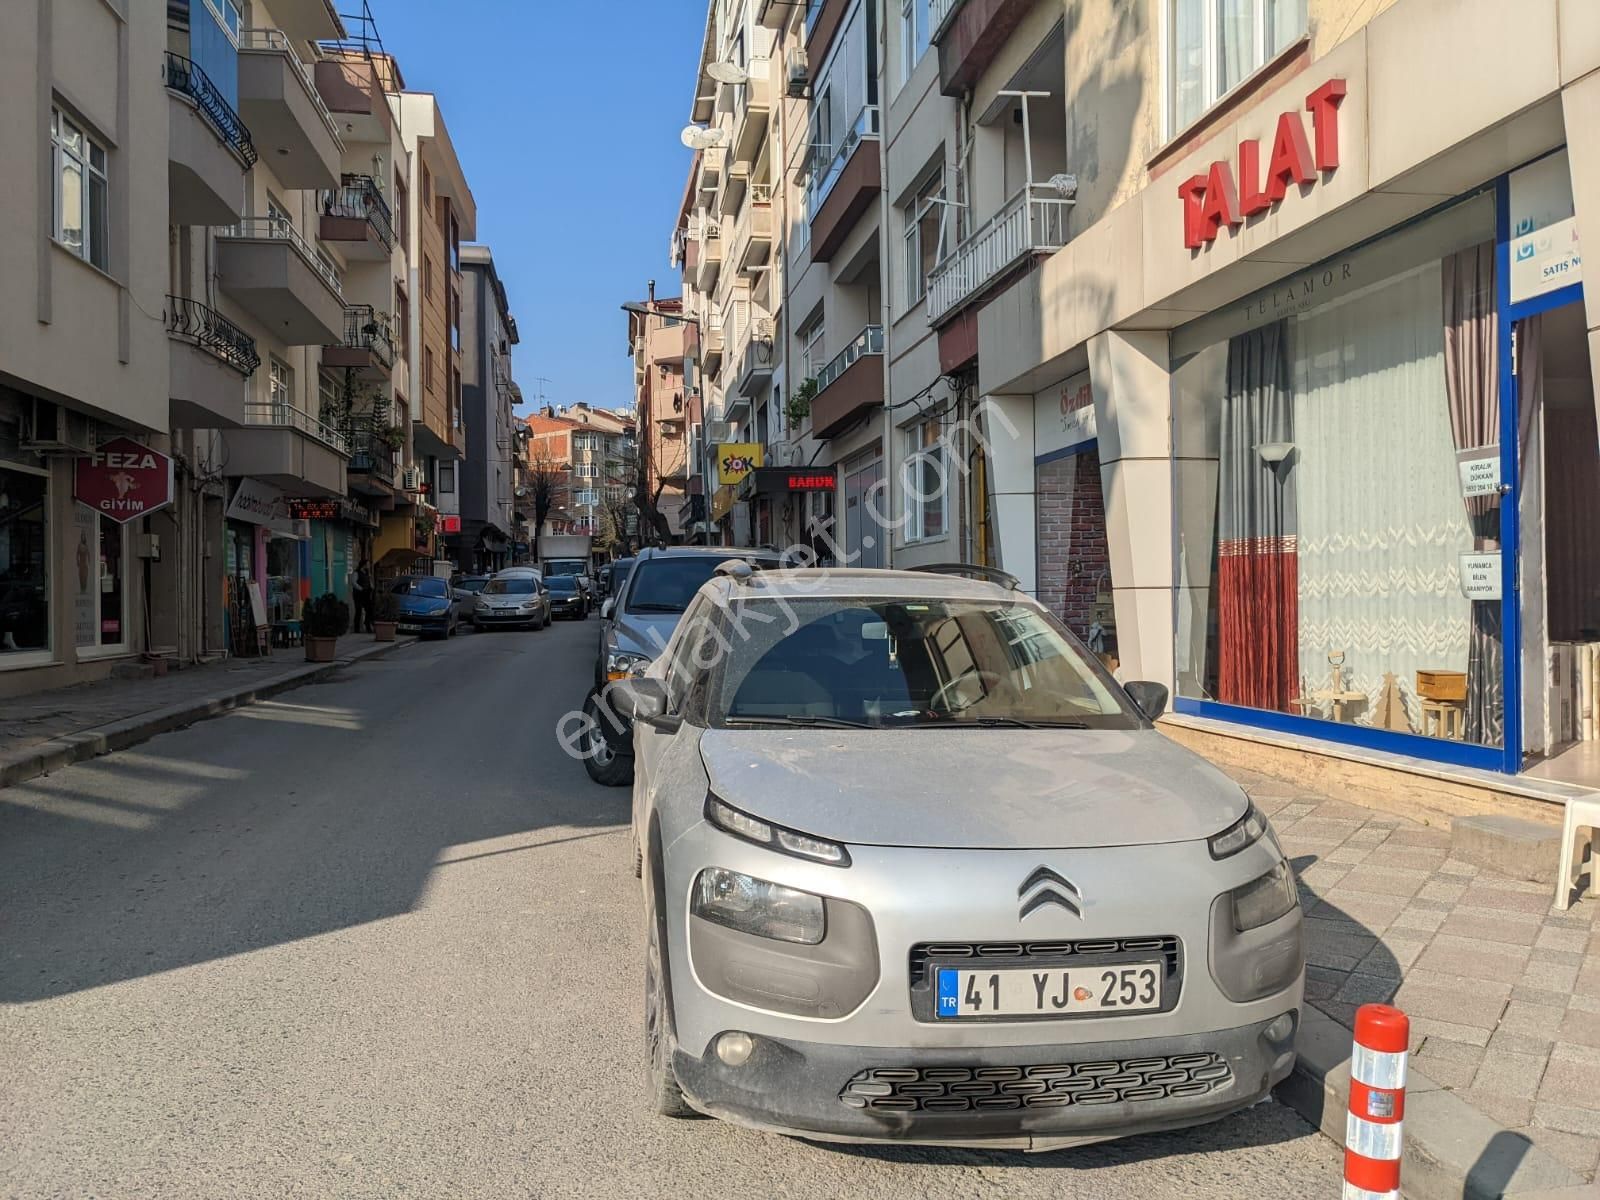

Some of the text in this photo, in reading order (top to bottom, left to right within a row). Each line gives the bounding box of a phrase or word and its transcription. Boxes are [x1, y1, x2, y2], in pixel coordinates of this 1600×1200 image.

[1178, 79, 1347, 249] TALAT
[91, 451, 158, 469] FEZA
[100, 498, 144, 511] GİYİM
[965, 968, 1156, 1011] 41 YJ 253
[942, 996, 956, 1007] TR
